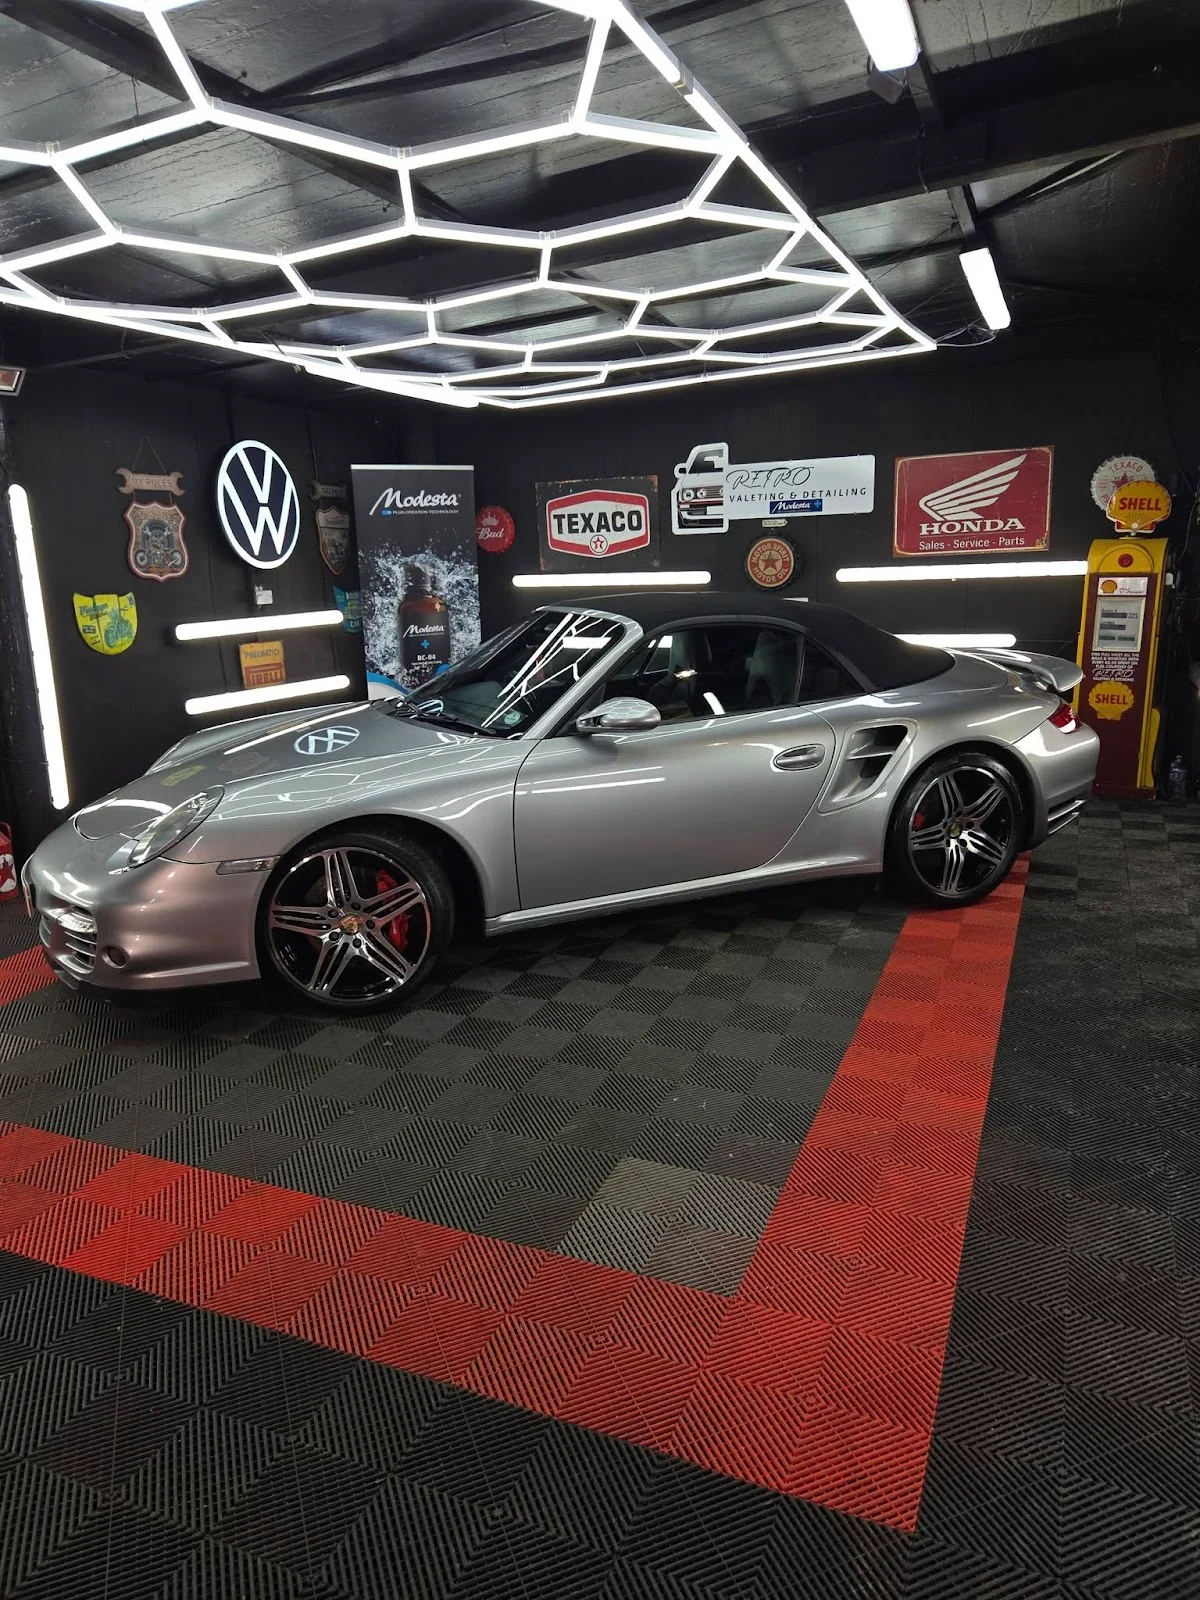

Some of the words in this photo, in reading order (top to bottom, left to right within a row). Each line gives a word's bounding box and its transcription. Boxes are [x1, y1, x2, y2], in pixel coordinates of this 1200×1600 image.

[1107, 461, 1143, 472] TEXACO
[726, 466, 815, 490] RETRO
[369, 487, 459, 516] Modesta
[729, 492, 784, 502] VALETING
[802, 487, 867, 498] DETAILING
[772, 501, 811, 514] Modesta
[1118, 498, 1162, 510] SHELL
[553, 510, 643, 535] TEXACO
[919, 518, 1026, 536] HONDA
[476, 527, 505, 540] Bud
[919, 541, 945, 550] Sales
[953, 538, 990, 549] Service
[998, 536, 1025, 546] Parts
[752, 543, 772, 563] MOTOR
[773, 543, 790, 562] SPIRIT
[753, 567, 776, 582] MOTOR
[777, 568, 789, 579] OIL
[402, 624, 445, 638] Modesta
[1092, 668, 1135, 677] RETRO
[1095, 694, 1128, 705] SHELL
